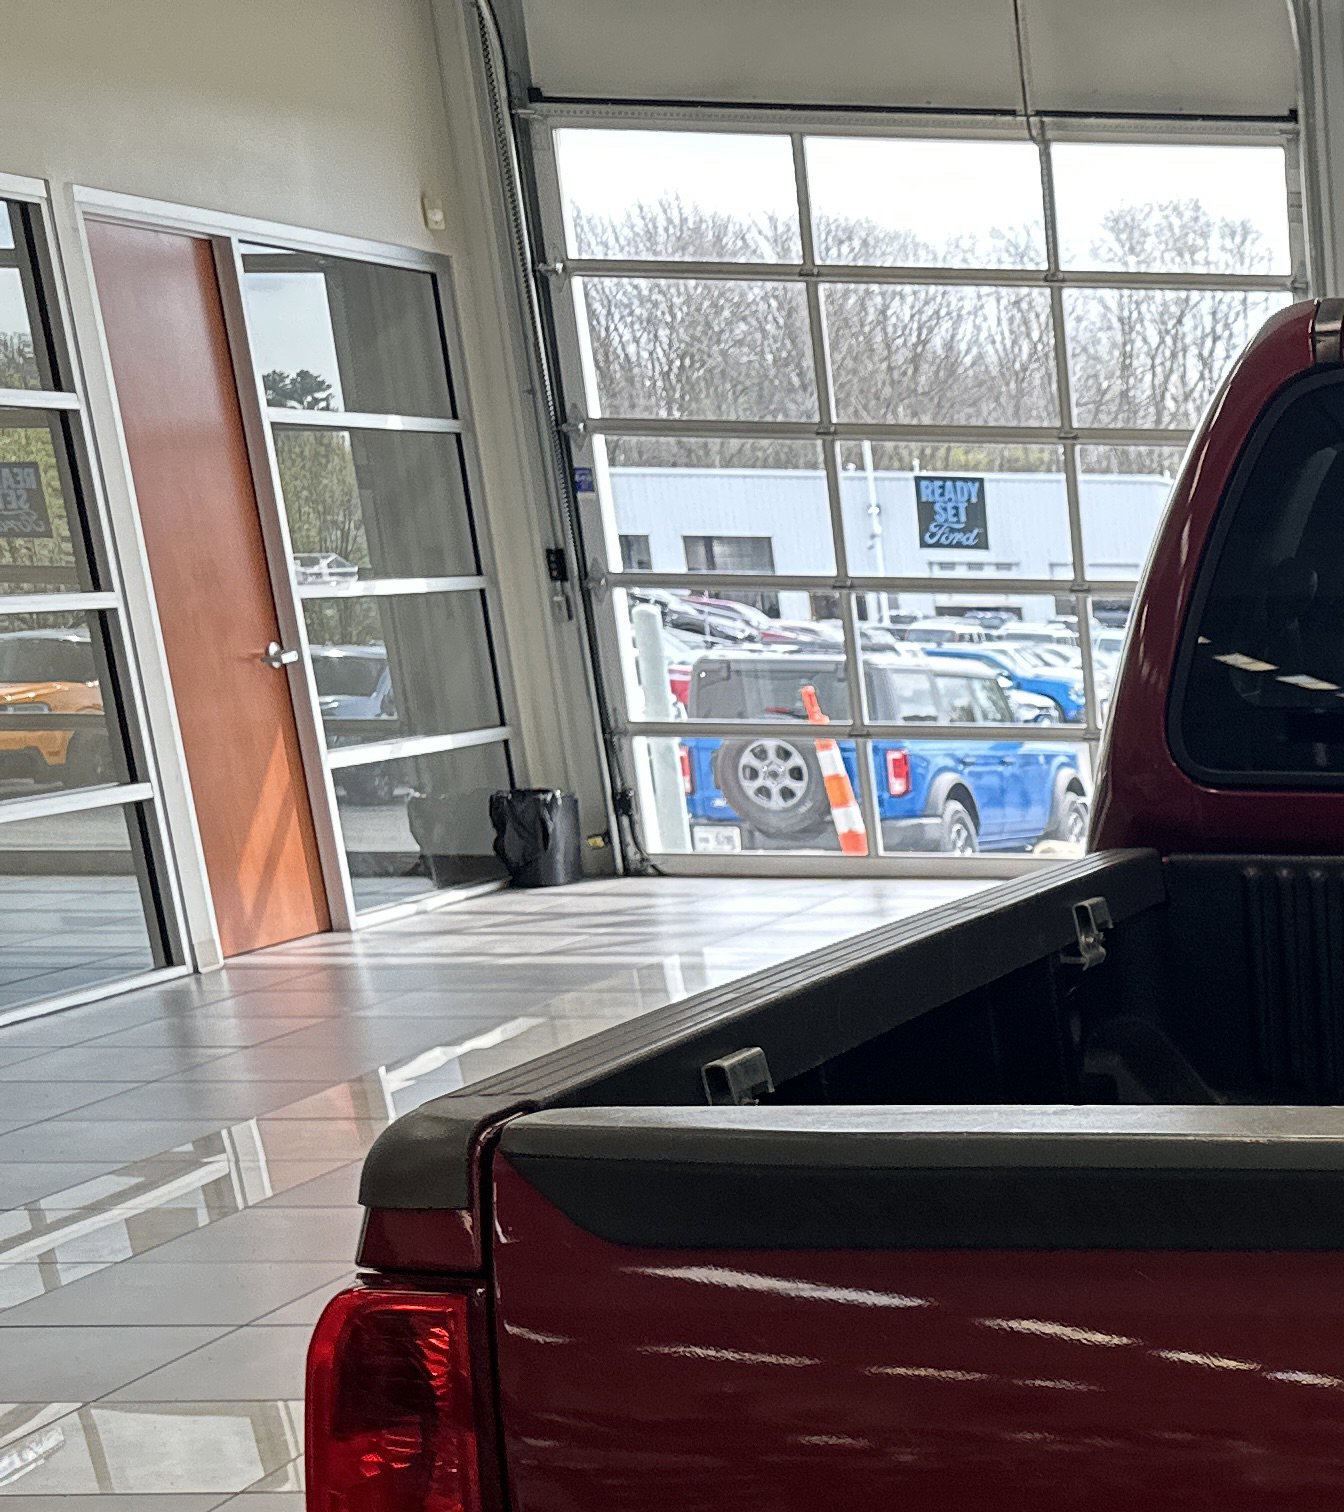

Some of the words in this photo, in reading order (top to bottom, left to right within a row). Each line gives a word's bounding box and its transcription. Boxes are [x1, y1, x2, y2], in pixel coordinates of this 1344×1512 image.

[919, 479, 980, 503] READY
[933, 501, 968, 524] SET
[924, 522, 979, 546] Ford
